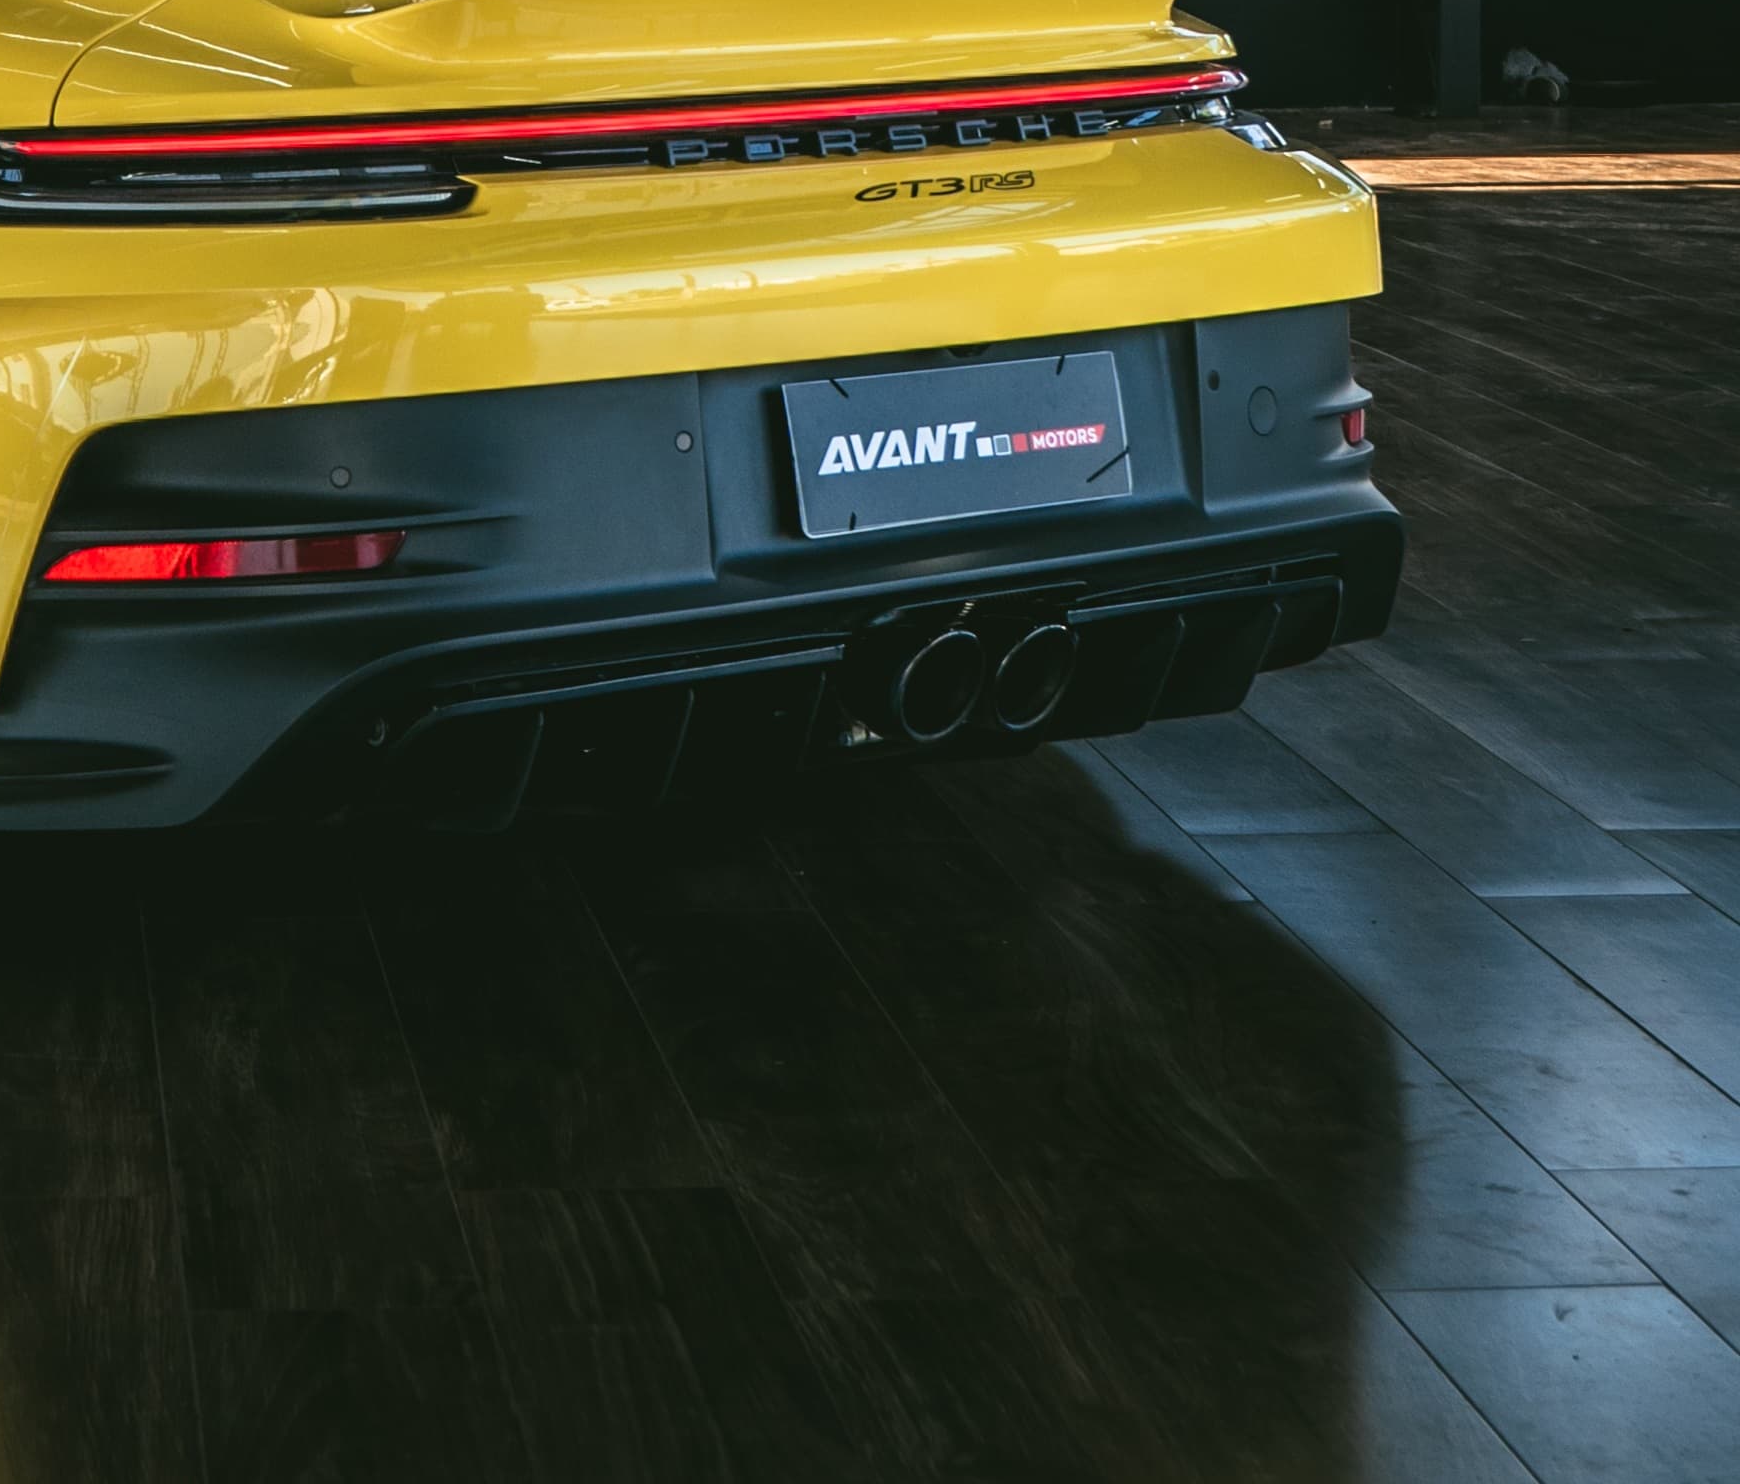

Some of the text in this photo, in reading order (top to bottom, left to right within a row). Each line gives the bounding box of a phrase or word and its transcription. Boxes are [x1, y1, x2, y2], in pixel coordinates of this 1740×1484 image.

[666, 109, 1111, 167] PORSCHE
[818, 420, 1100, 476] AVANT MOTORS
